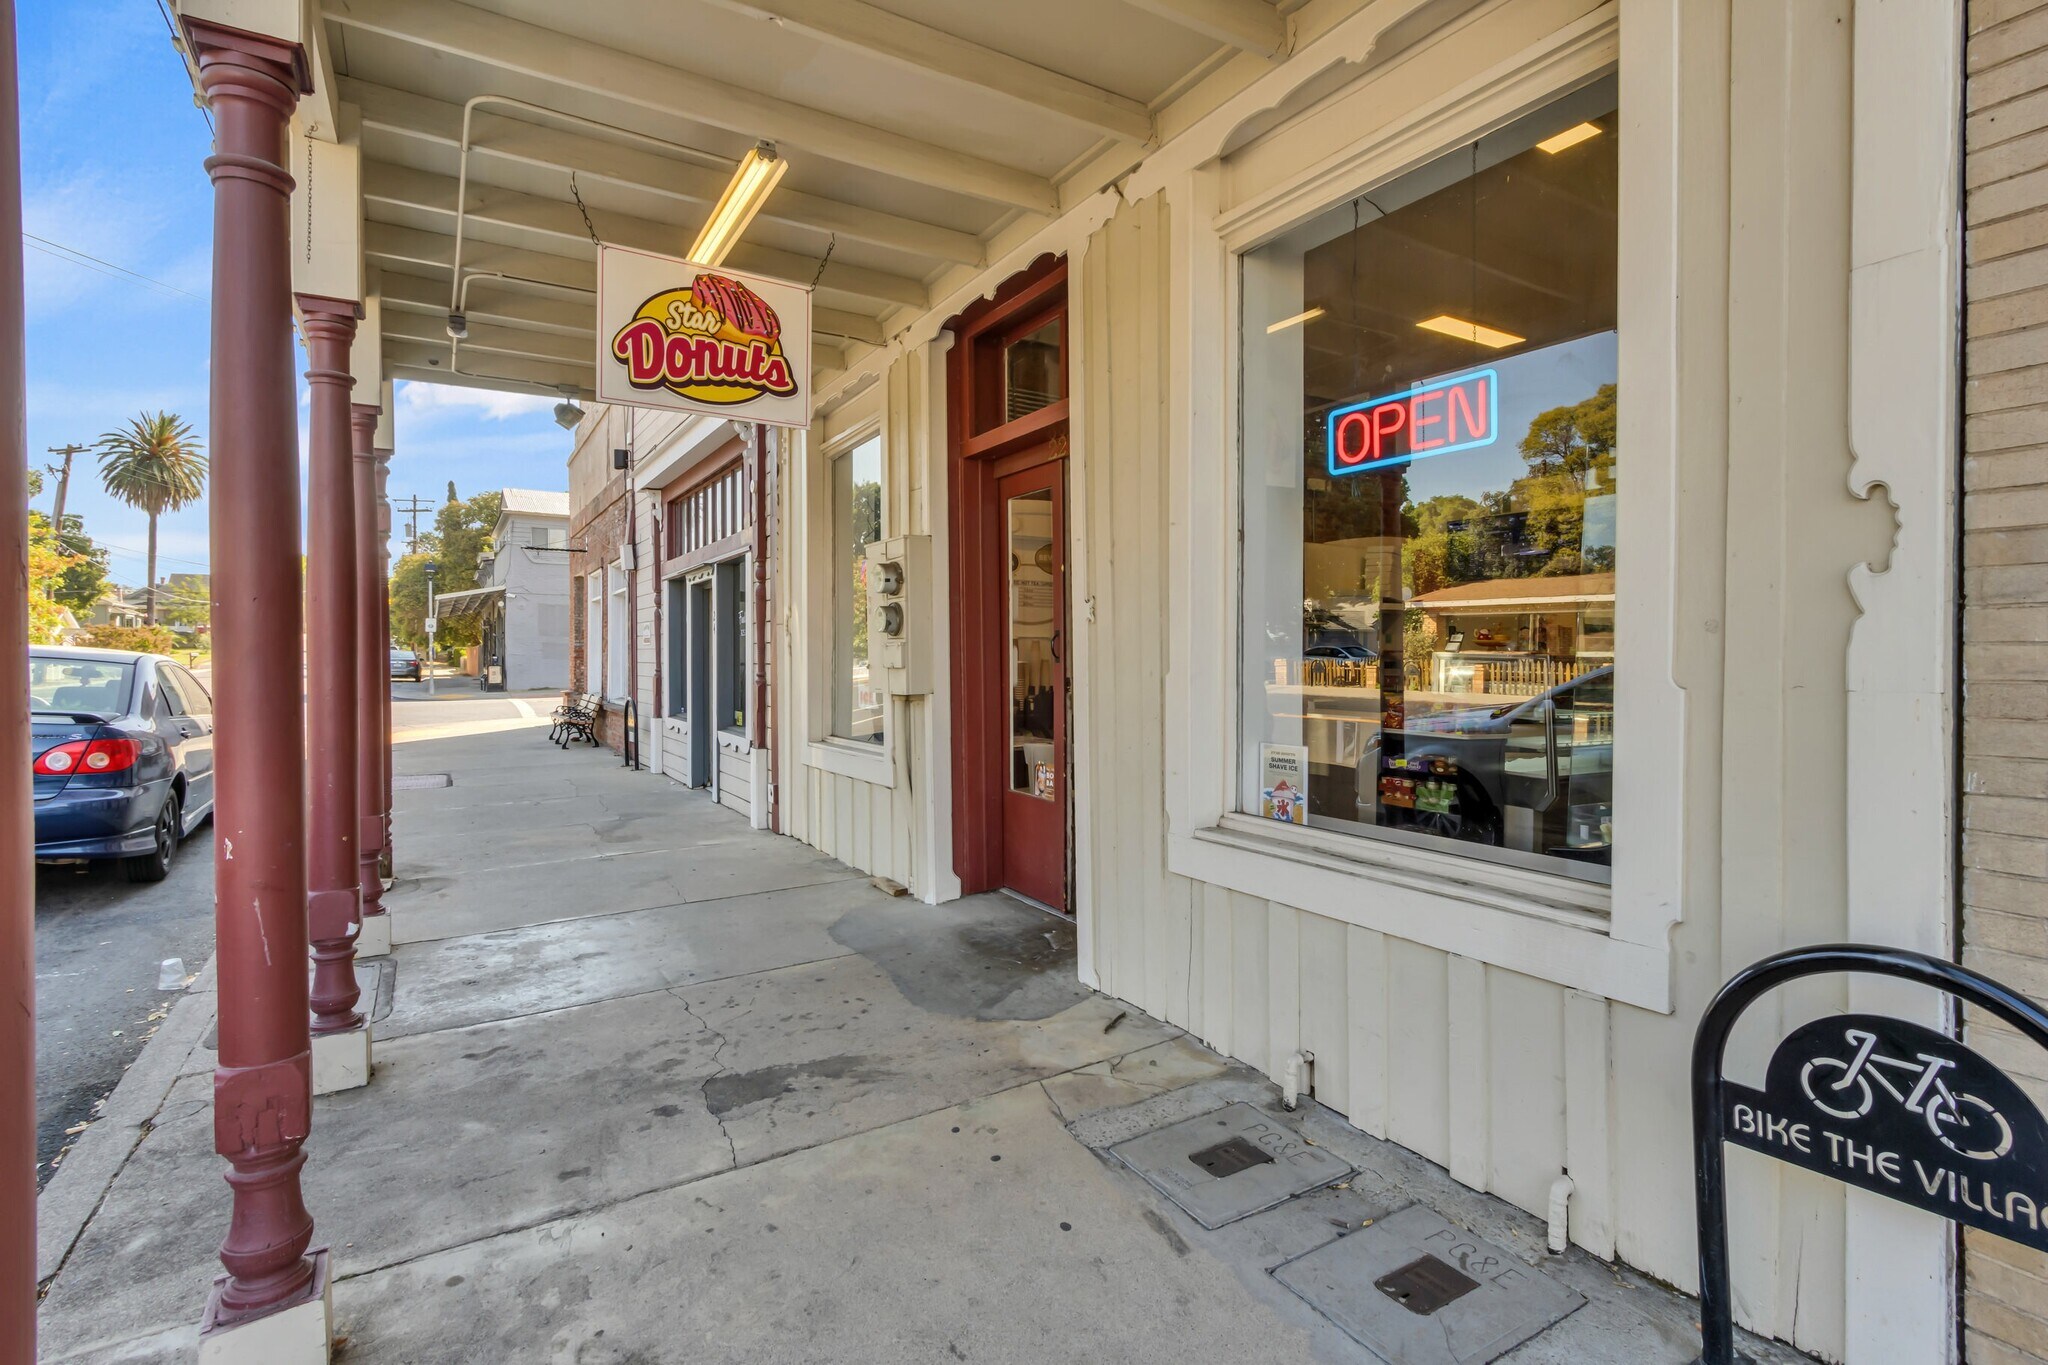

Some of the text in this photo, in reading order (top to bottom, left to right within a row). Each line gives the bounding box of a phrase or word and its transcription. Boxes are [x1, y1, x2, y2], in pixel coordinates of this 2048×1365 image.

[664, 299, 722, 335] Star
[614, 320, 793, 391] Donuts
[1336, 379, 1487, 464] OPEN
[1268, 762, 1298, 772] SHAVE ICE
[1270, 756, 1296, 765] SUMMER
[1242, 1122, 1315, 1166] PG&E
[1733, 1104, 1812, 1154] BIKE
[1823, 1130, 1901, 1184] THE
[1424, 1229, 1528, 1290] PG&E
